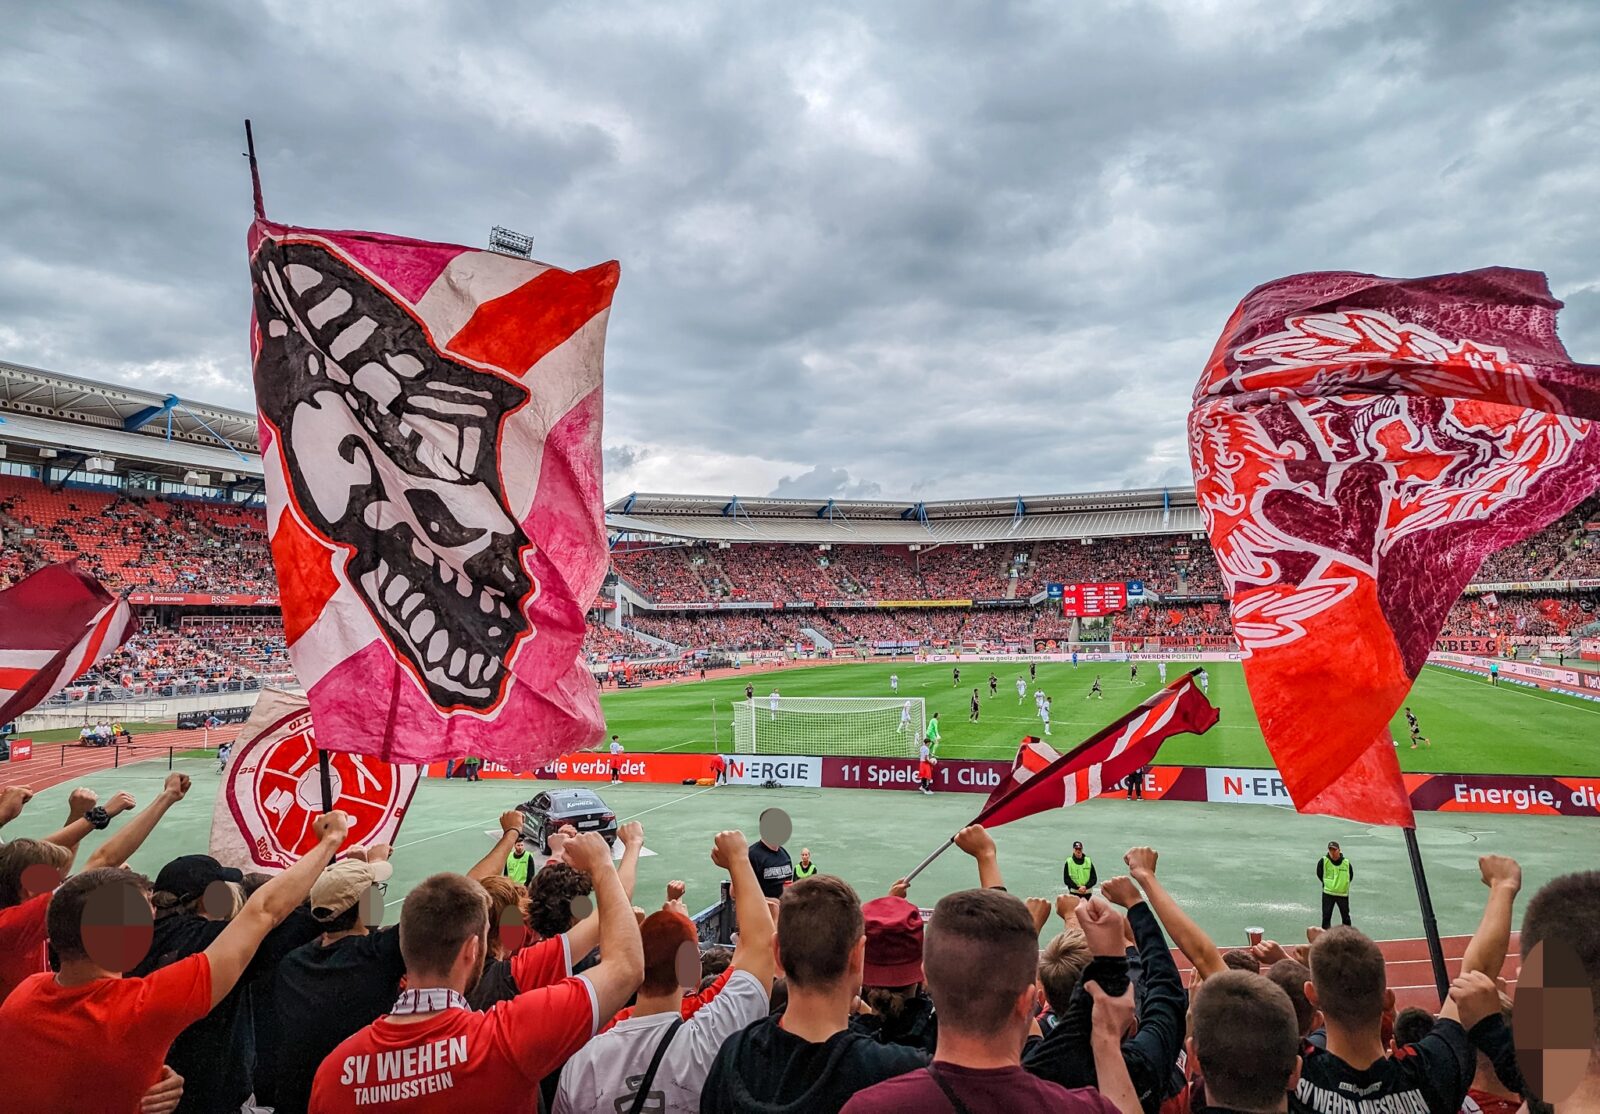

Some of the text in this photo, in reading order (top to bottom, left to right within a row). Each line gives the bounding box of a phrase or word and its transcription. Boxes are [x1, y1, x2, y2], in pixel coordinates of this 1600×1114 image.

[545, 758, 567, 774] die
[572, 758, 646, 776] verbidet
[841, 765, 860, 780] 11
[941, 768, 948, 784] 1
[957, 768, 1001, 785] Club
[1454, 783, 1562, 810] Energie,
[340, 1035, 468, 1085] SV WEHEN
[354, 1071, 453, 1105] TAUNUSSTEIN
[1295, 1078, 1314, 1104] SV
